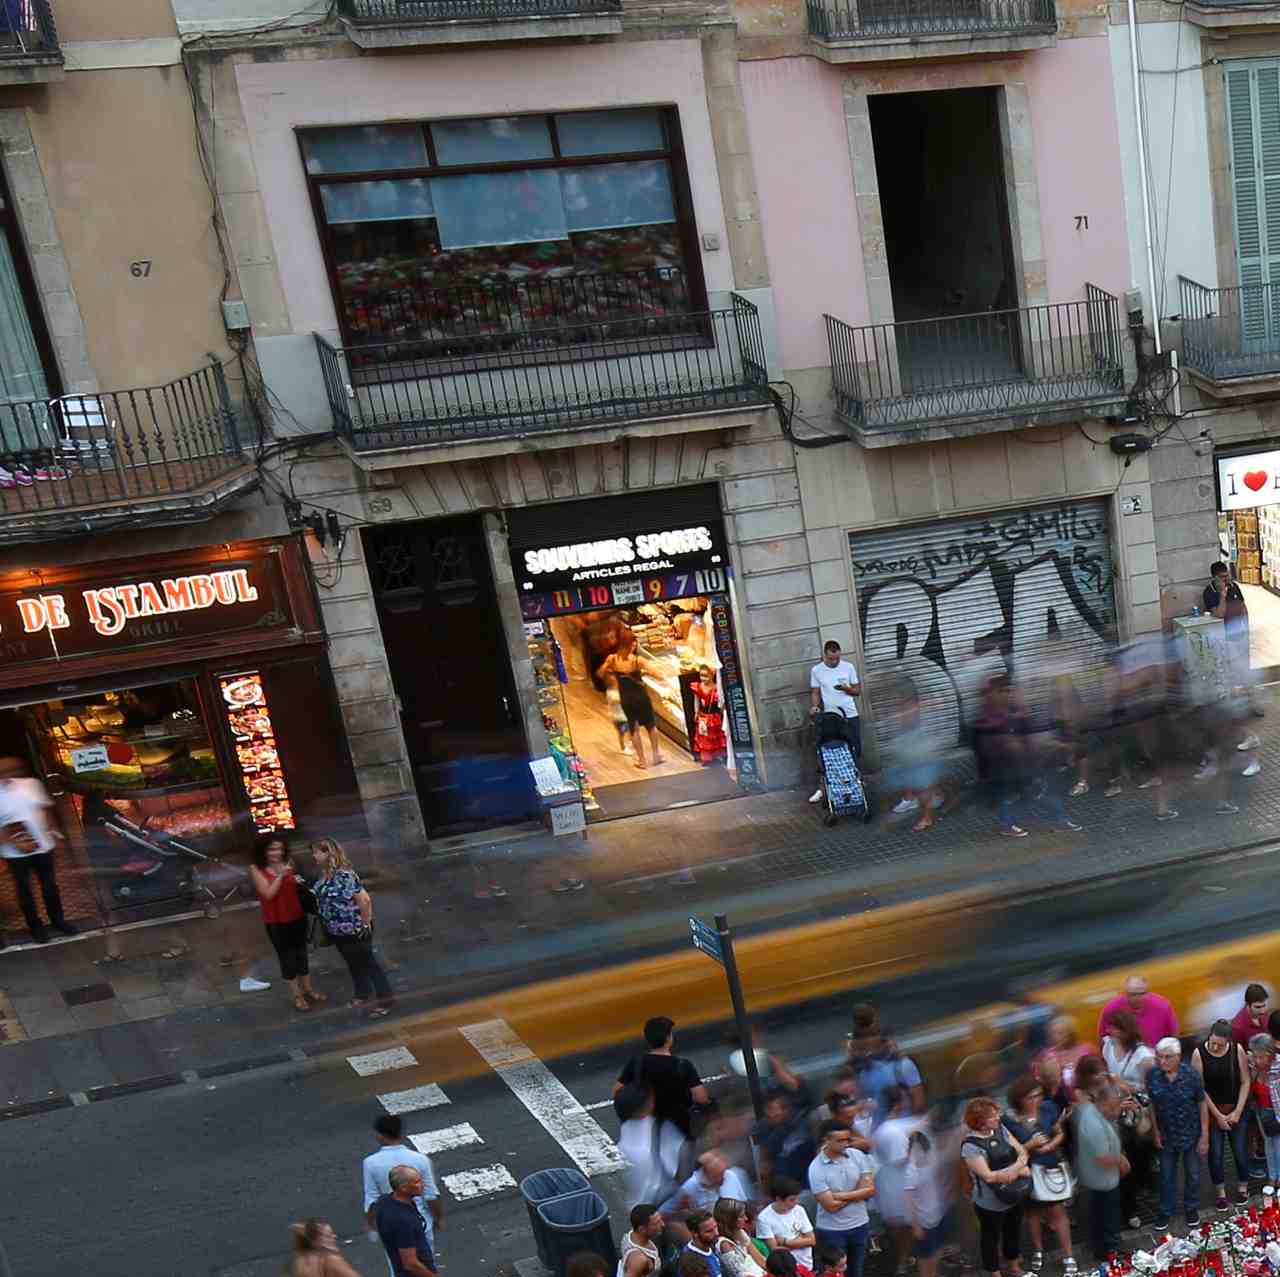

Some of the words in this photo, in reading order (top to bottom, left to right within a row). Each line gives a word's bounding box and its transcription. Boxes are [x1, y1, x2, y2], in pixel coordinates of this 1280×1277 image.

[1073, 215, 1089, 230] 71
[130, 261, 152, 278] 67
[1227, 473, 1238, 496] I
[524, 537, 635, 574] SOUVENIRS
[635, 526, 713, 559] SPORTS
[572, 564, 632, 581] ARTICLES
[633, 560, 675, 573] REGAL
[17, 594, 70, 633] DE
[83, 570, 258, 636] ISTAMBUL
